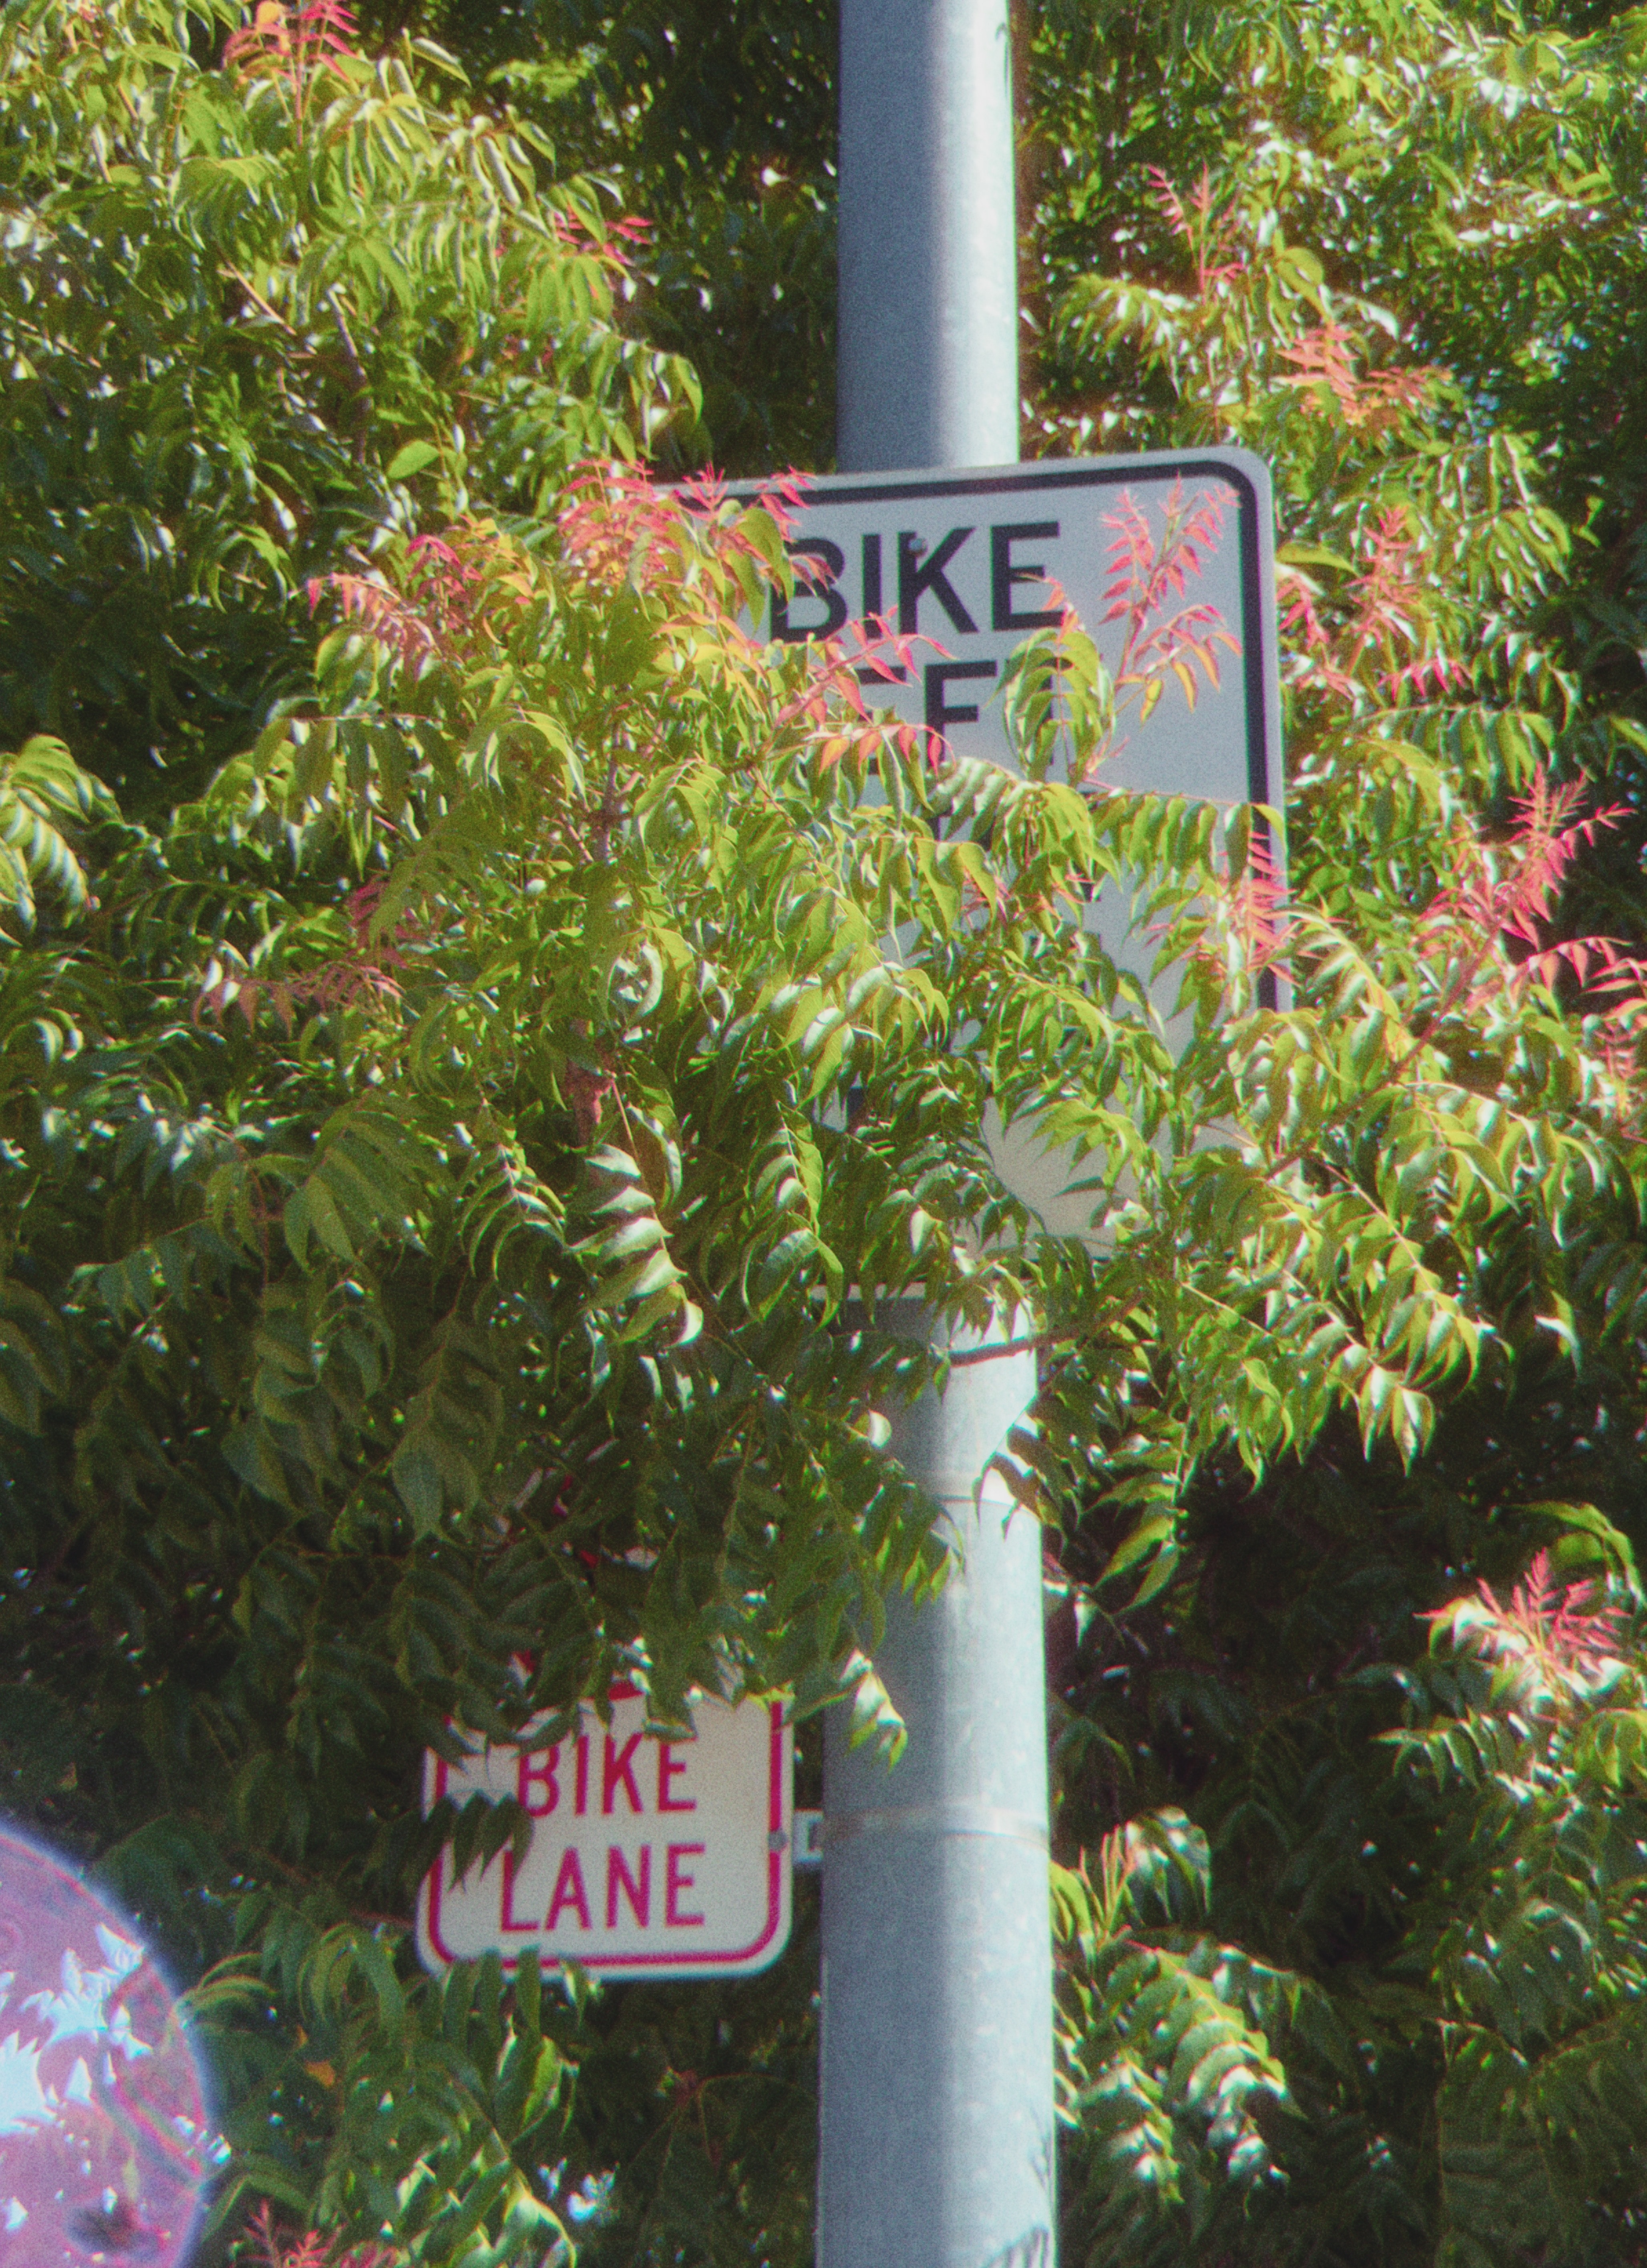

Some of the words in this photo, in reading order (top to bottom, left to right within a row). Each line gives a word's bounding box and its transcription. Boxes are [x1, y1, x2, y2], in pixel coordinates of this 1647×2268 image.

[769, 520, 1066, 643] BIKE
[518, 1732, 697, 1818] BIKE
[500, 1844, 705, 1931] LANE
